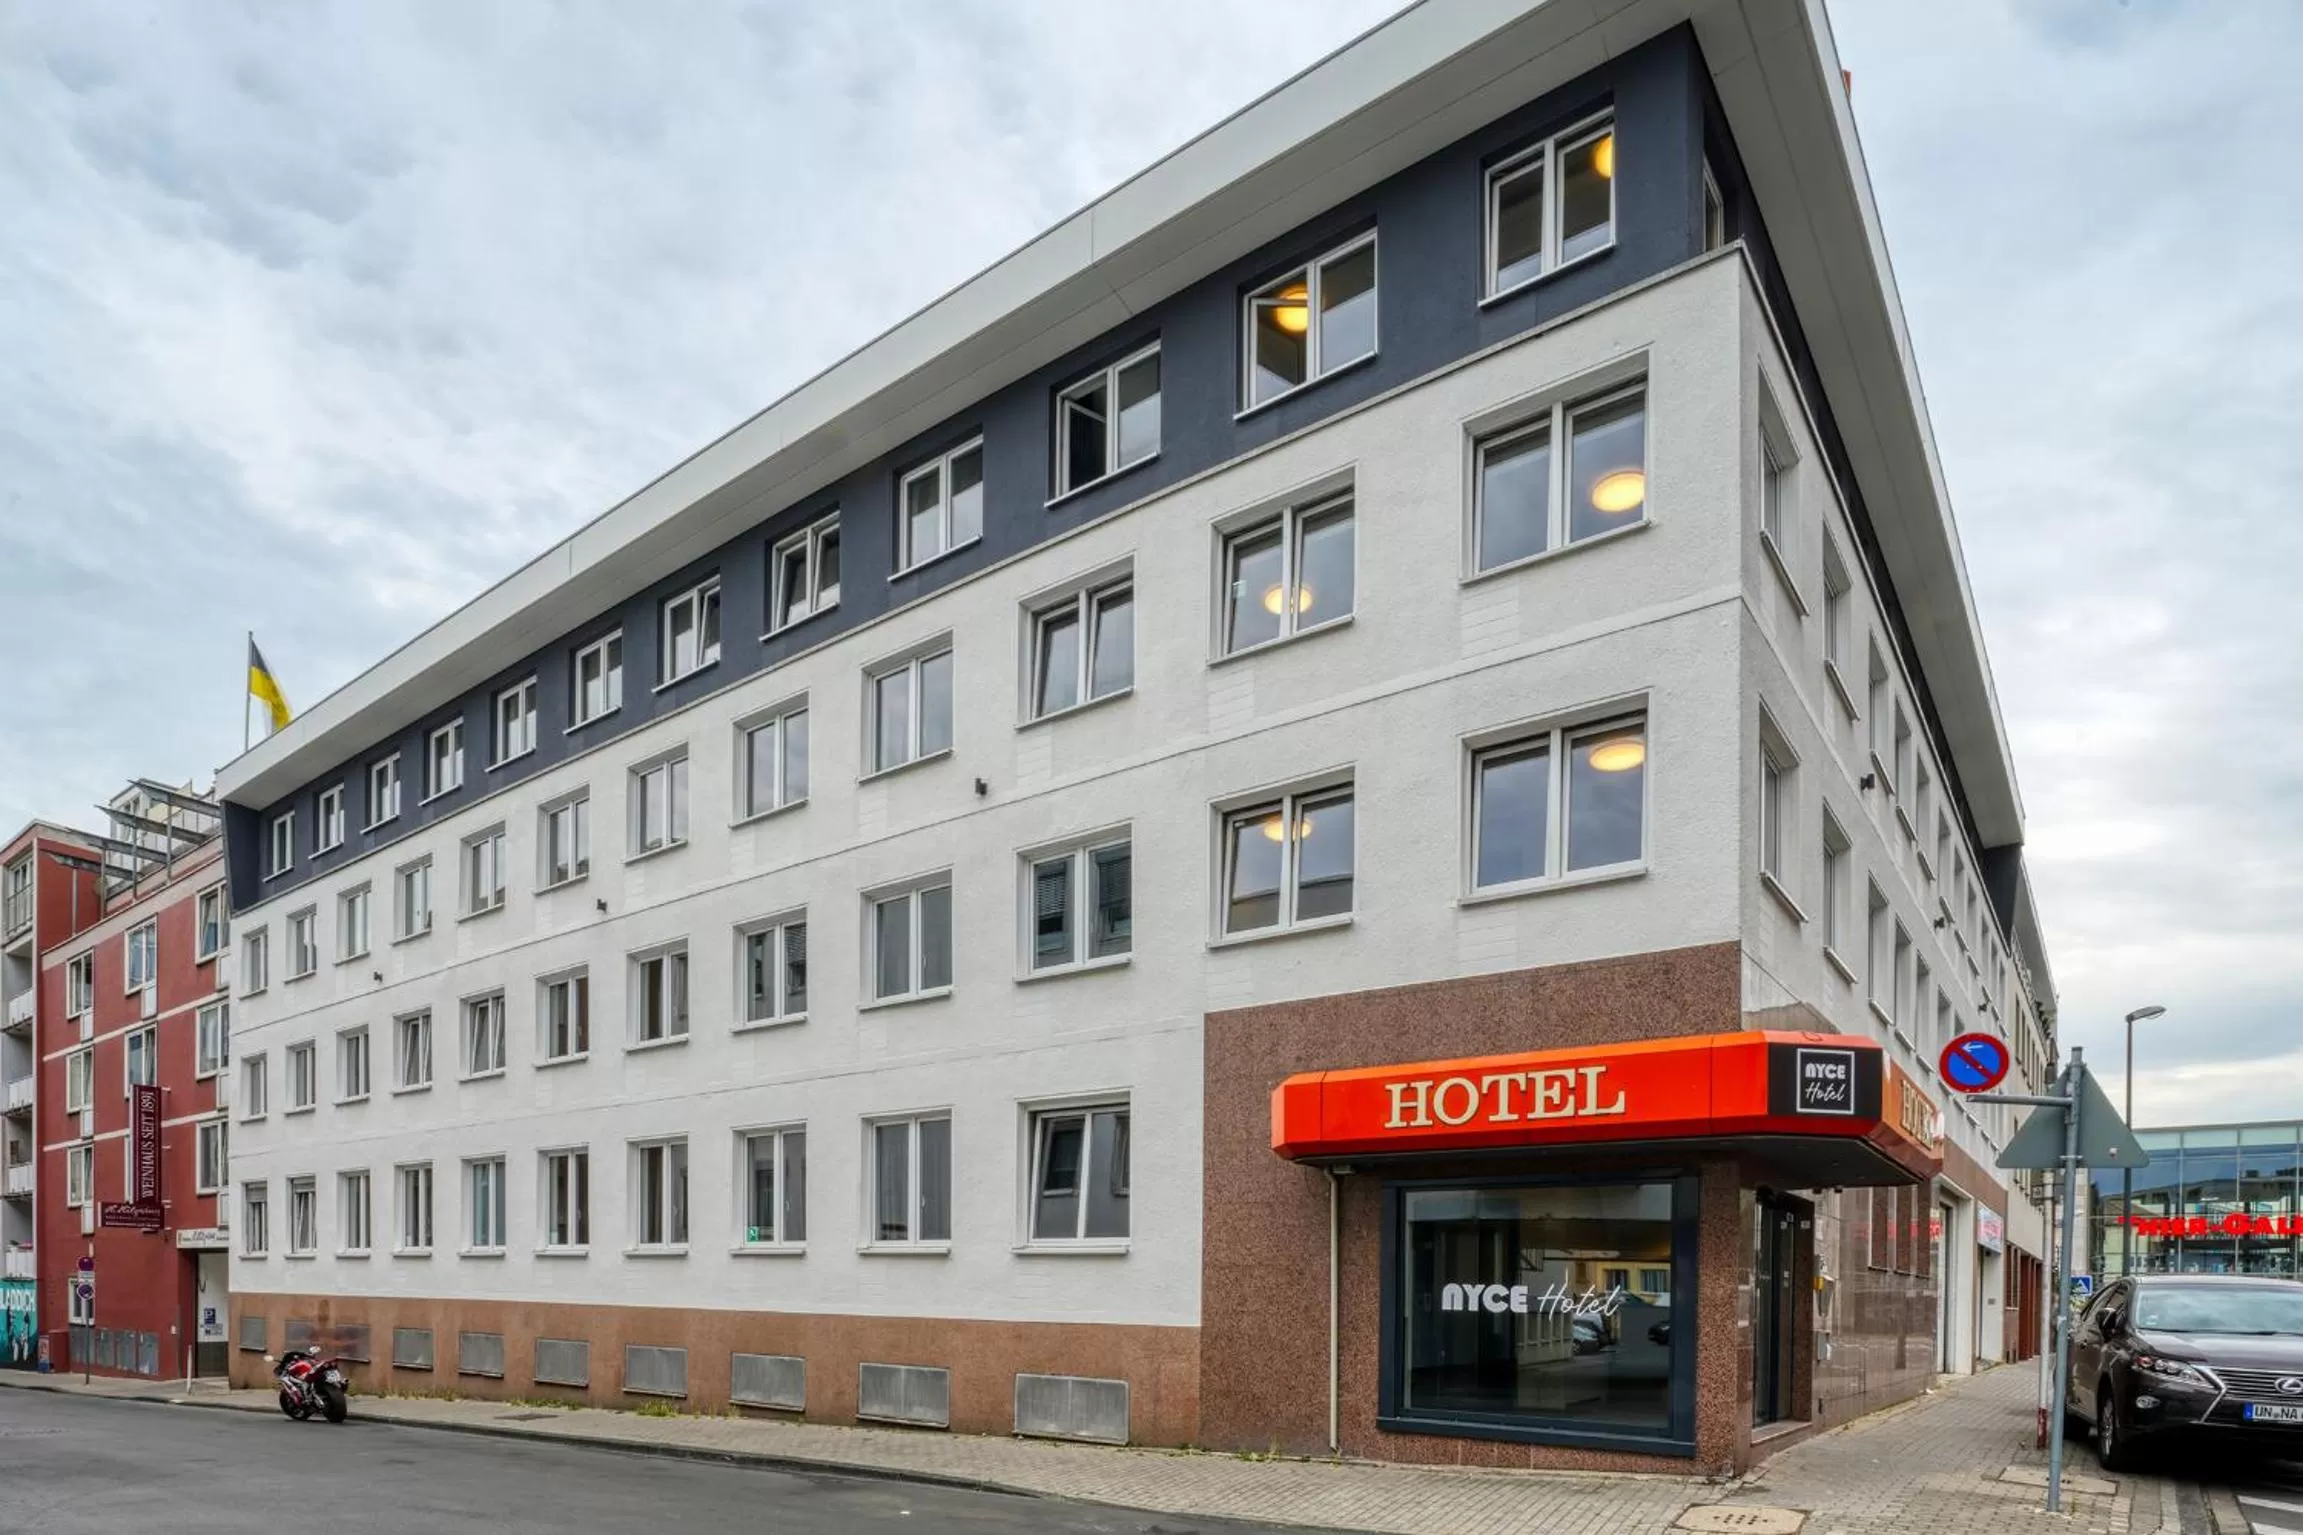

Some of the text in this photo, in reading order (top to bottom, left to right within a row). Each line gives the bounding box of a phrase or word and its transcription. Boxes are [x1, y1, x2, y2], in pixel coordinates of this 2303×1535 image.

[1805, 1062, 1847, 1079] NYCE
[1384, 1066, 1626, 1128] HOTEL
[1805, 1081, 1846, 1104] Hotel
[140, 1091, 157, 1198] WEINHAUS SEIT 1891
[1442, 1267, 1622, 1321] NYCE Hotel
[2255, 1406, 2298, 1419] UN NA
